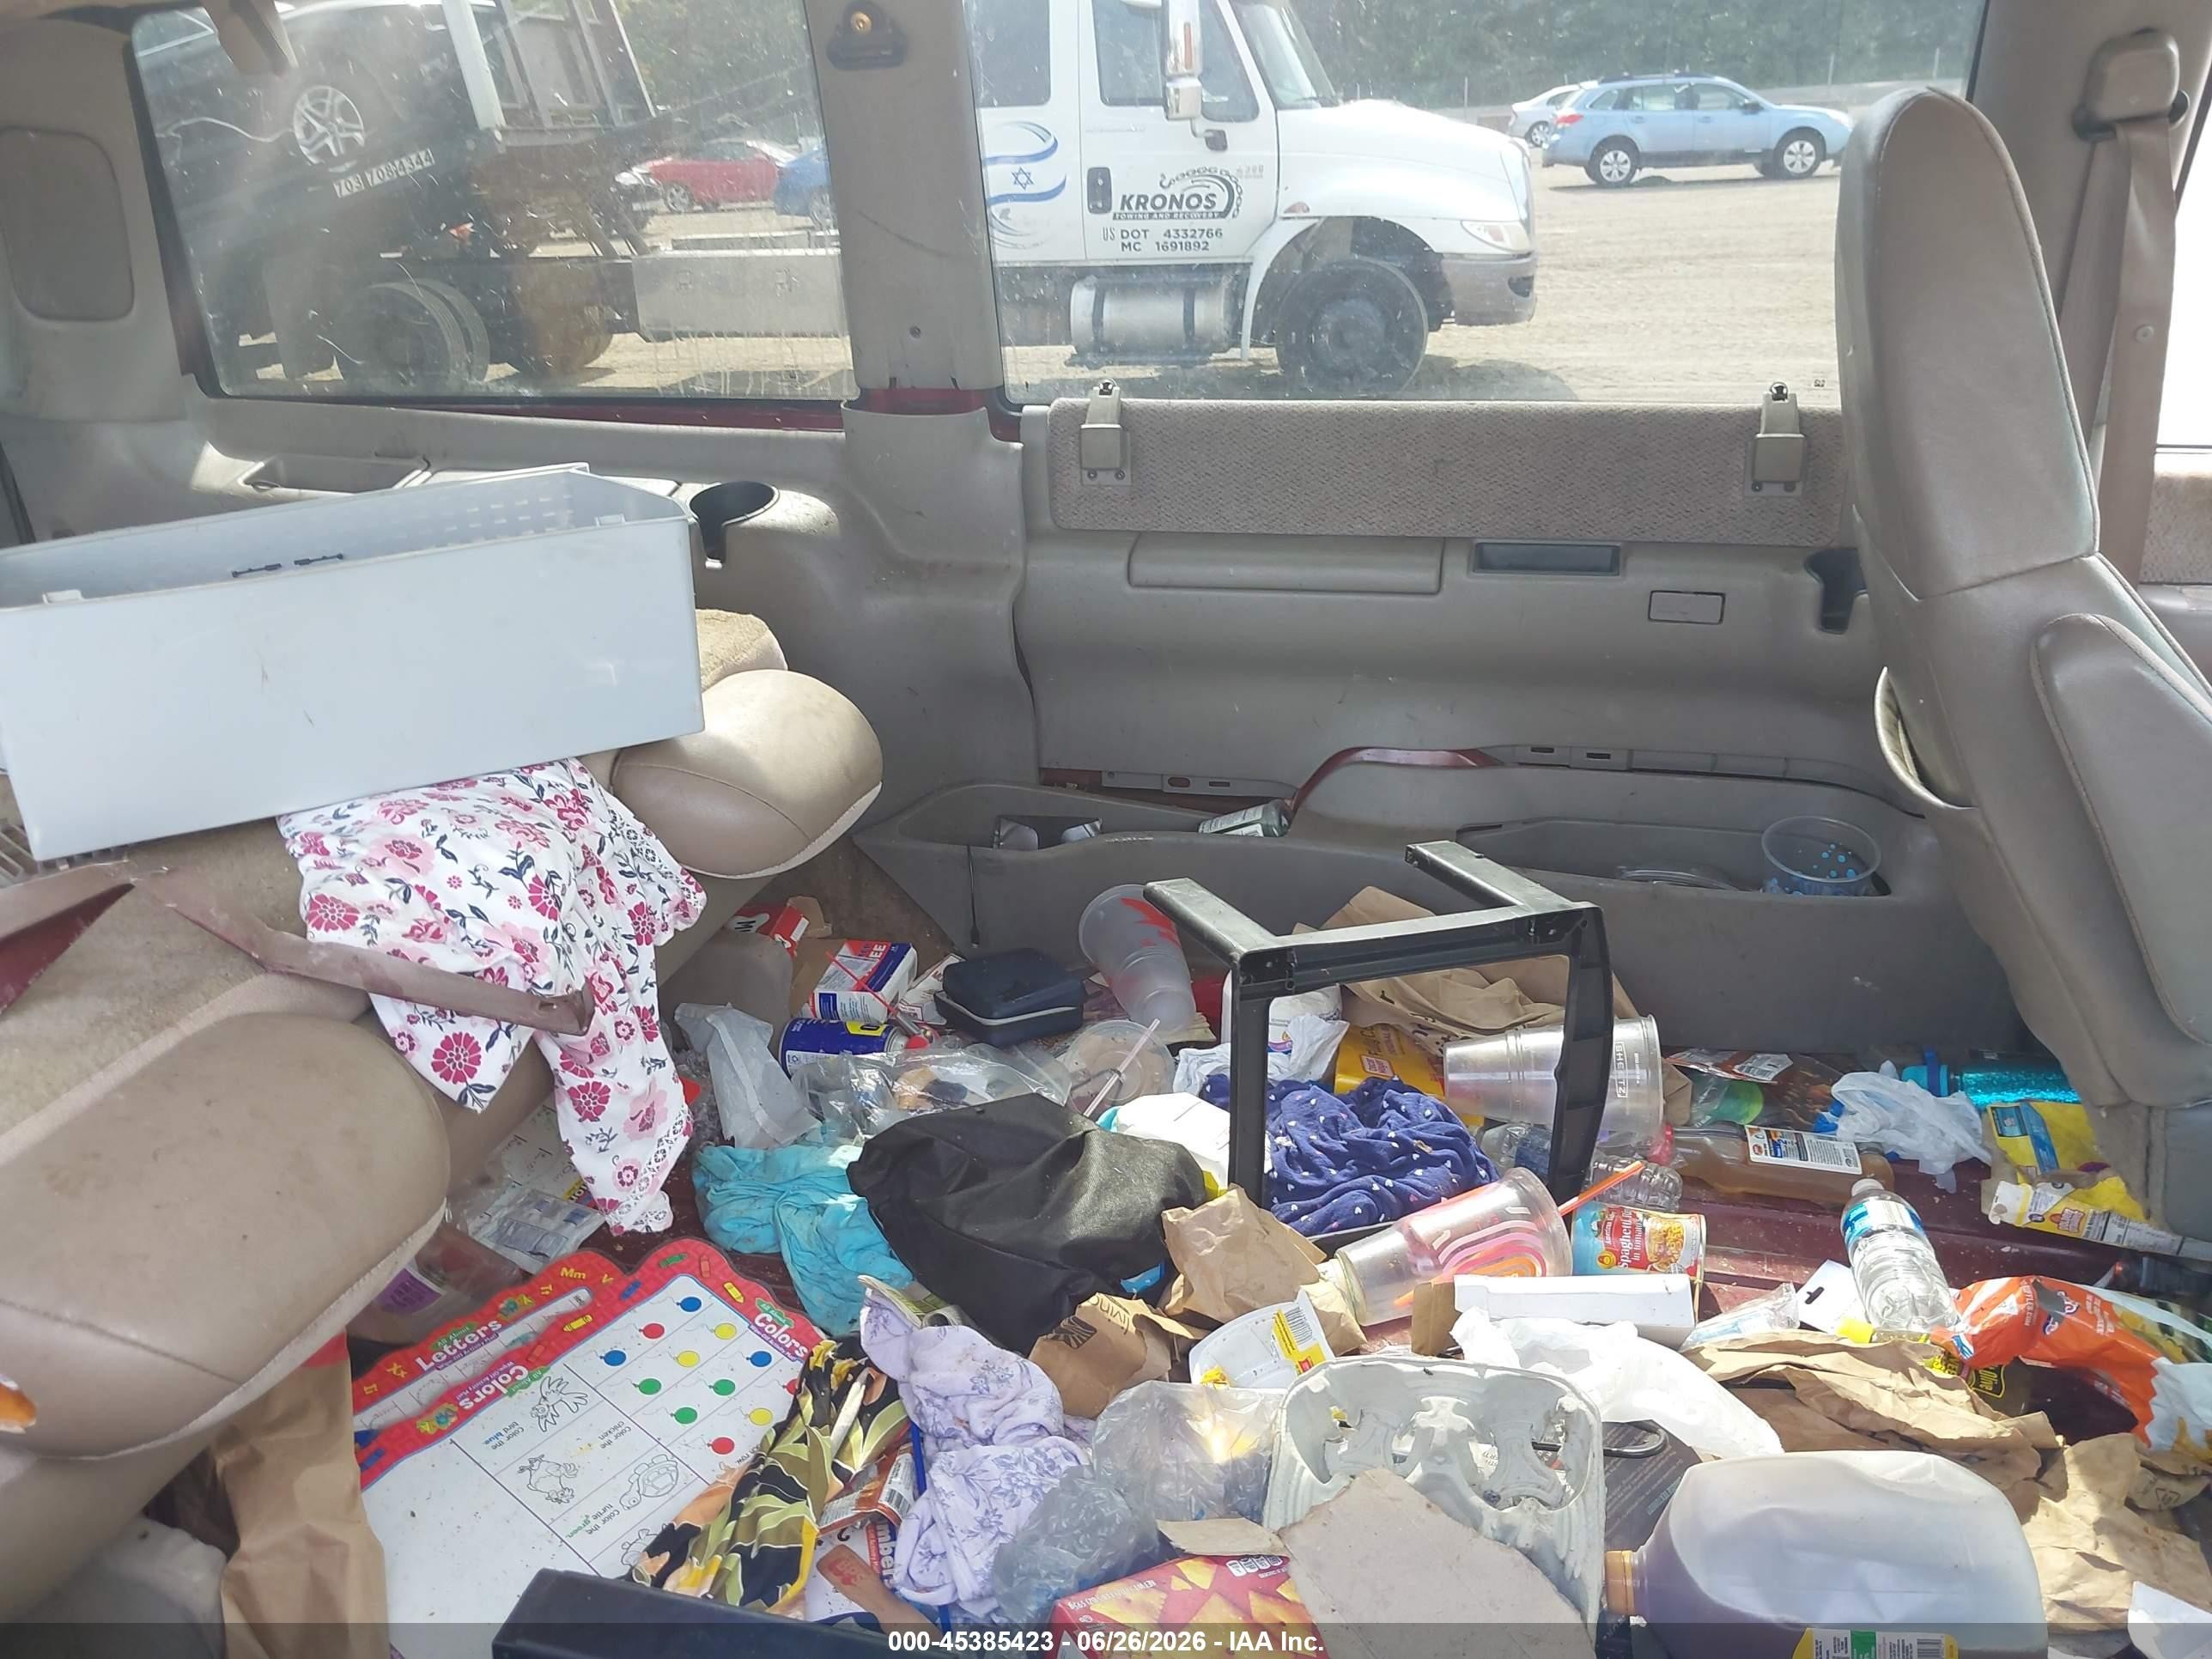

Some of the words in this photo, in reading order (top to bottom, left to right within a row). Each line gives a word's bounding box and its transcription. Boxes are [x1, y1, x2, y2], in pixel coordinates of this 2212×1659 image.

[332, 173, 364, 198] 703
[1120, 193, 1217, 211] KRONOS
[1103, 228, 1115, 241] US
[1120, 228, 1150, 240] DOT
[1163, 228, 1223, 240] 4332766
[1121, 241, 1141, 252] MC
[1155, 241, 1209, 252] 1691892
[754, 1312, 808, 1357] Colors
[415, 1319, 502, 1371] Letters
[458, 1364, 530, 1412] Colors
[501, 1420, 520, 1435] bird
[503, 1425, 525, 1442] Color
[598, 1419, 626, 1442] chicken
[611, 1425, 632, 1441] Color
[490, 1438, 505, 1451] the
[599, 1437, 614, 1450] the
[590, 1502, 614, 1522] turtle
[599, 1508, 621, 1526] Color
[585, 1522, 600, 1536] the
